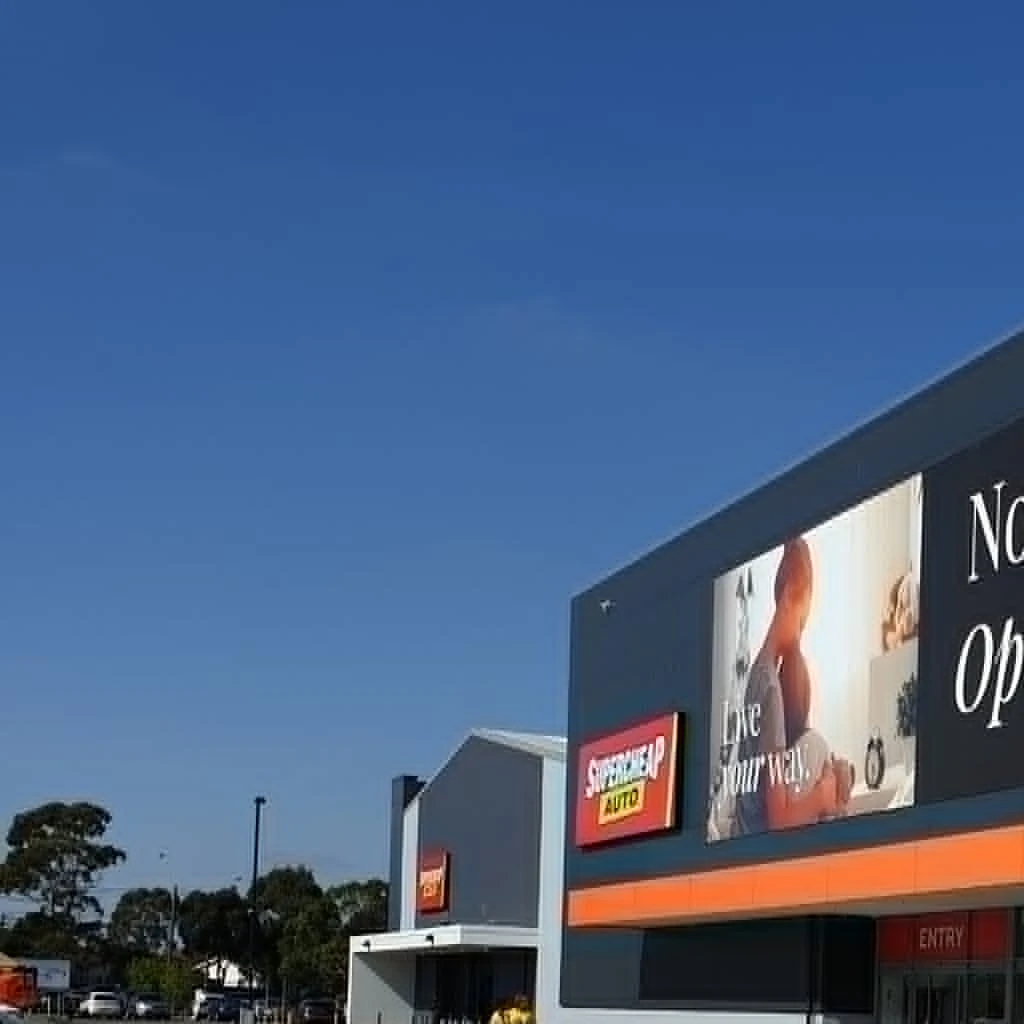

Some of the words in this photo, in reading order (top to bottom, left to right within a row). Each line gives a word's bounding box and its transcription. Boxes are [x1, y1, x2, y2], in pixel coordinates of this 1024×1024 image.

[720, 700, 761, 745] Live
[585, 735, 666, 800] SUPERCHEAP
[603, 788, 639, 816] AUTO
[918, 925, 964, 950] ENTRY
